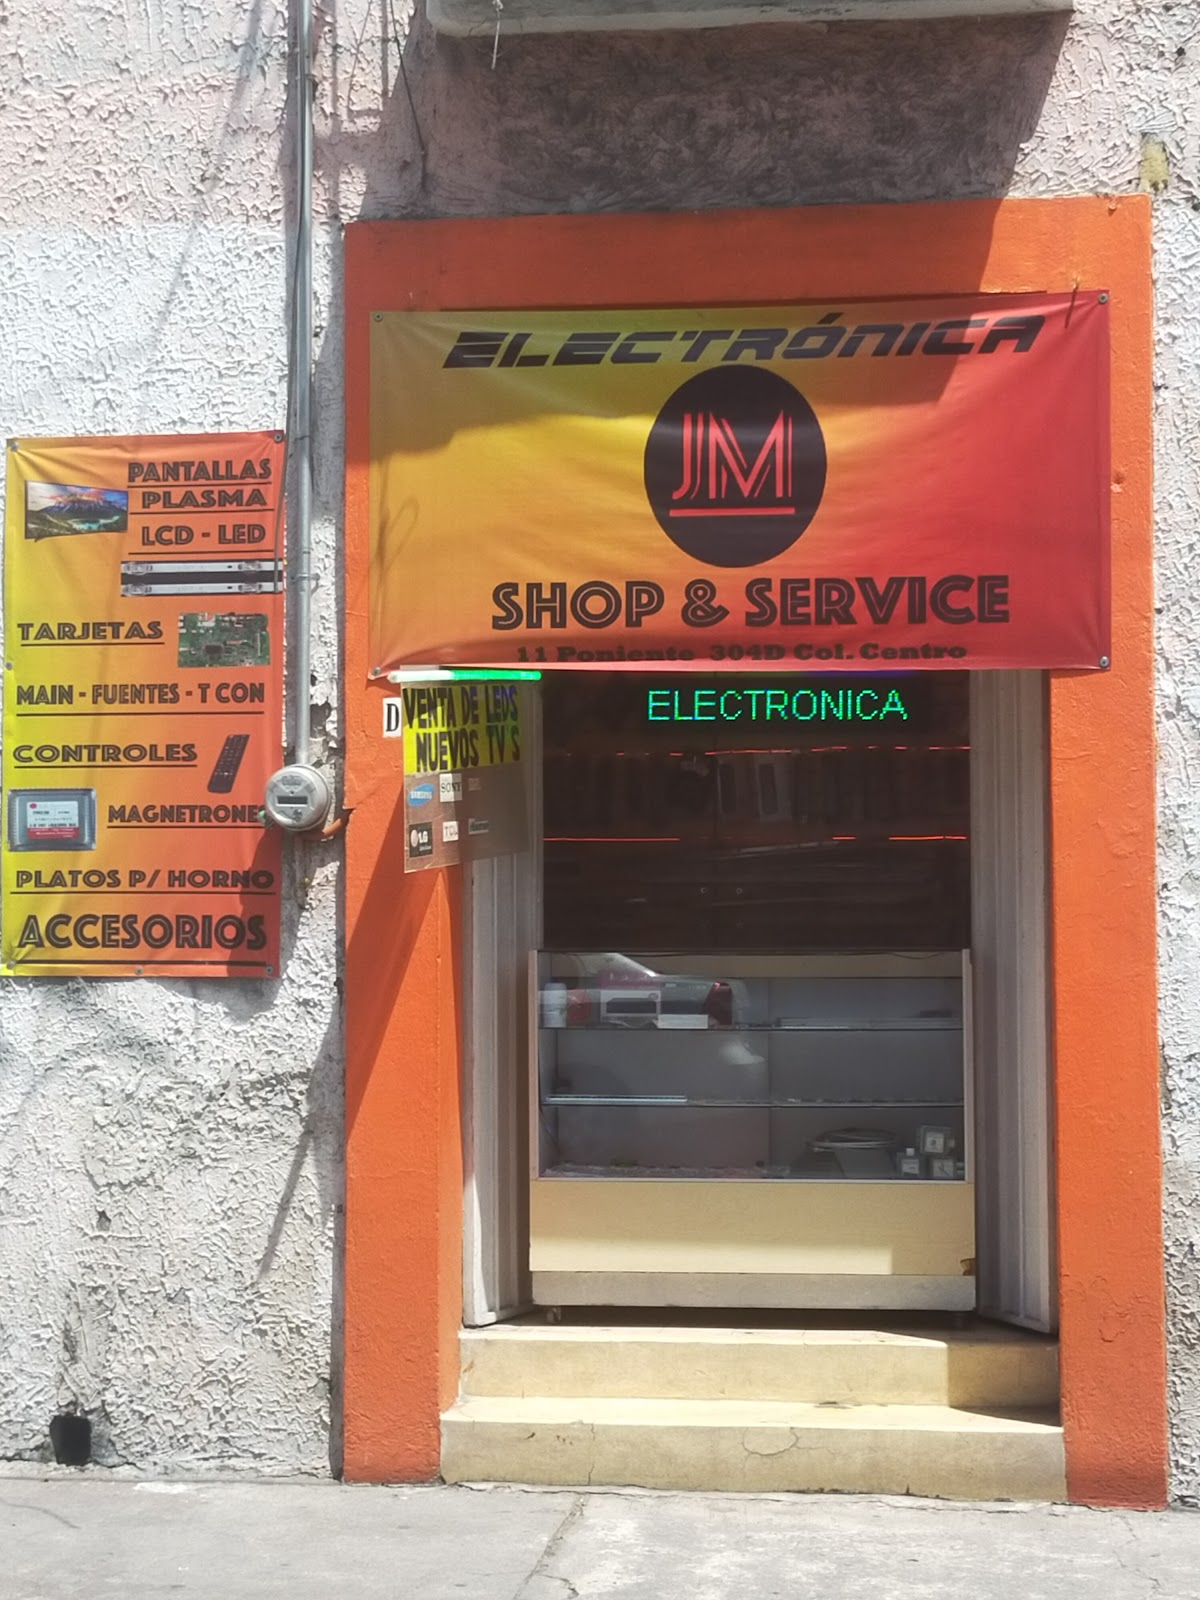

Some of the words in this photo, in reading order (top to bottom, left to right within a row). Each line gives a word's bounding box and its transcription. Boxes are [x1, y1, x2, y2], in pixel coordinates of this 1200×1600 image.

[442, 312, 1046, 368] ELECTRÓNICA
[671, 408, 793, 500] JM
[127, 459, 272, 482] PANTALLAS
[141, 488, 267, 509] PLASMA
[142, 525, 194, 546] LCD
[218, 524, 266, 545] LED
[491, 579, 665, 631] SHOP
[680, 578, 730, 628] &
[744, 575, 1010, 627] SERVICE
[17, 621, 163, 641] TARJETAS
[517, 646, 547, 662] 11
[793, 642, 854, 661] Col.
[859, 642, 968, 660] Centro
[16, 684, 74, 705] MAIN
[92, 683, 180, 705] FUENTES
[402, 687, 458, 730] VENTA
[460, 685, 480, 726] DE
[485, 684, 519, 724] LEDS
[648, 689, 909, 721] ELECTRONICA
[385, 703, 400, 732] D
[13, 743, 198, 763] CONTROLES
[416, 727, 480, 773] NUEVOS
[16, 869, 122, 889] PLATOS
[129, 869, 162, 889] P/
[168, 869, 275, 889] HORNO
[17, 913, 268, 949] ACCESORIOS
